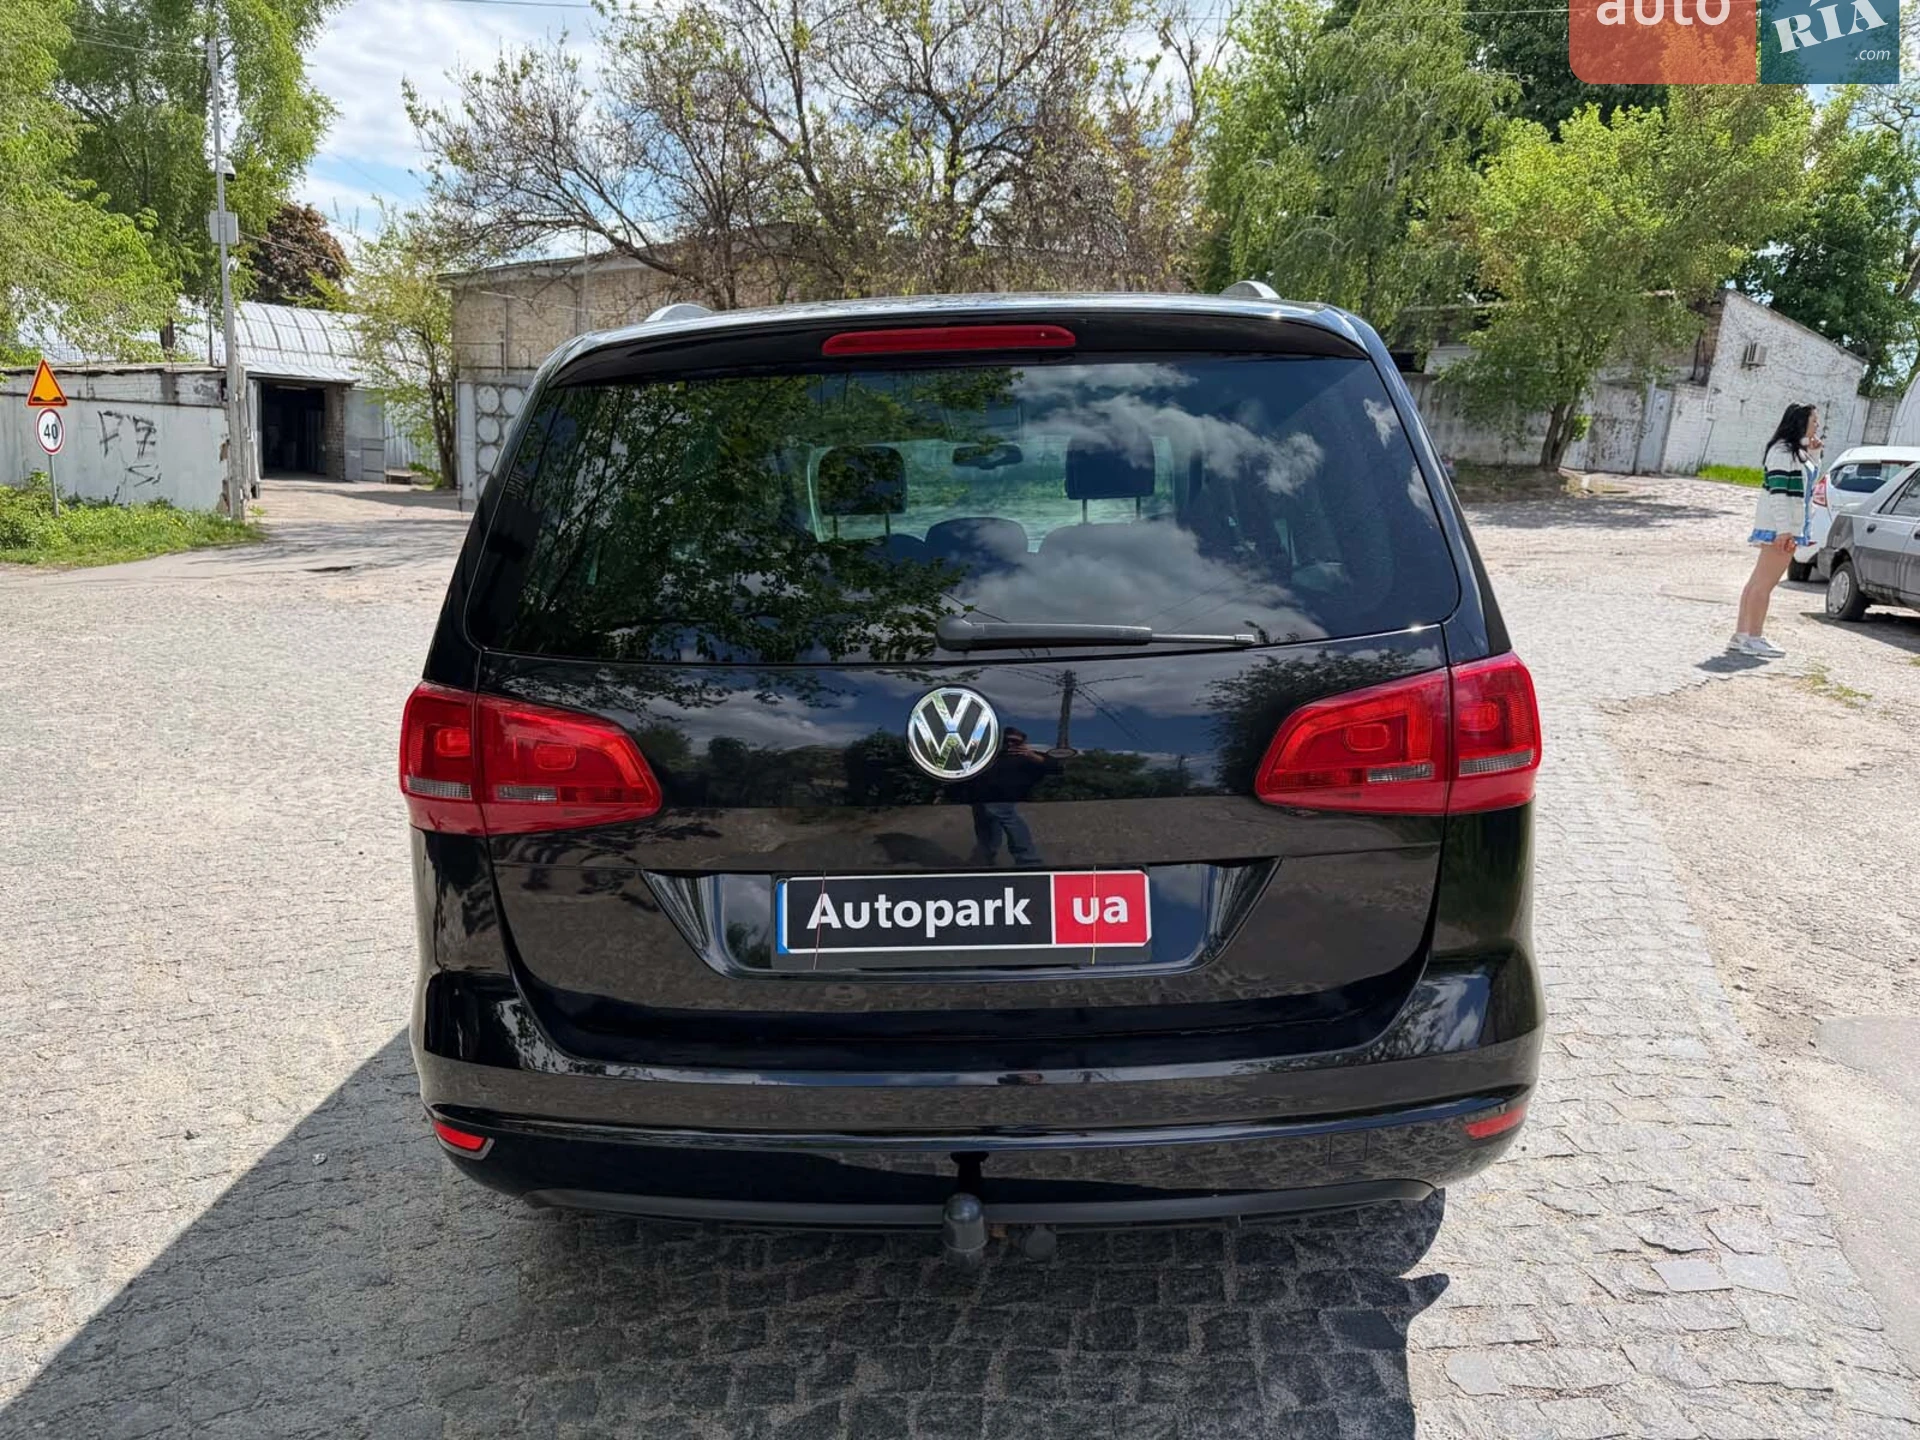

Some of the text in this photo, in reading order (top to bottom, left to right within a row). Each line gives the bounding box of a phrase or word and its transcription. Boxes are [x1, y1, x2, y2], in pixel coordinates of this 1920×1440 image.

[43, 423, 59, 440] 40
[908, 688, 998, 778] VW
[806, 887, 1129, 938] Autopark ua
